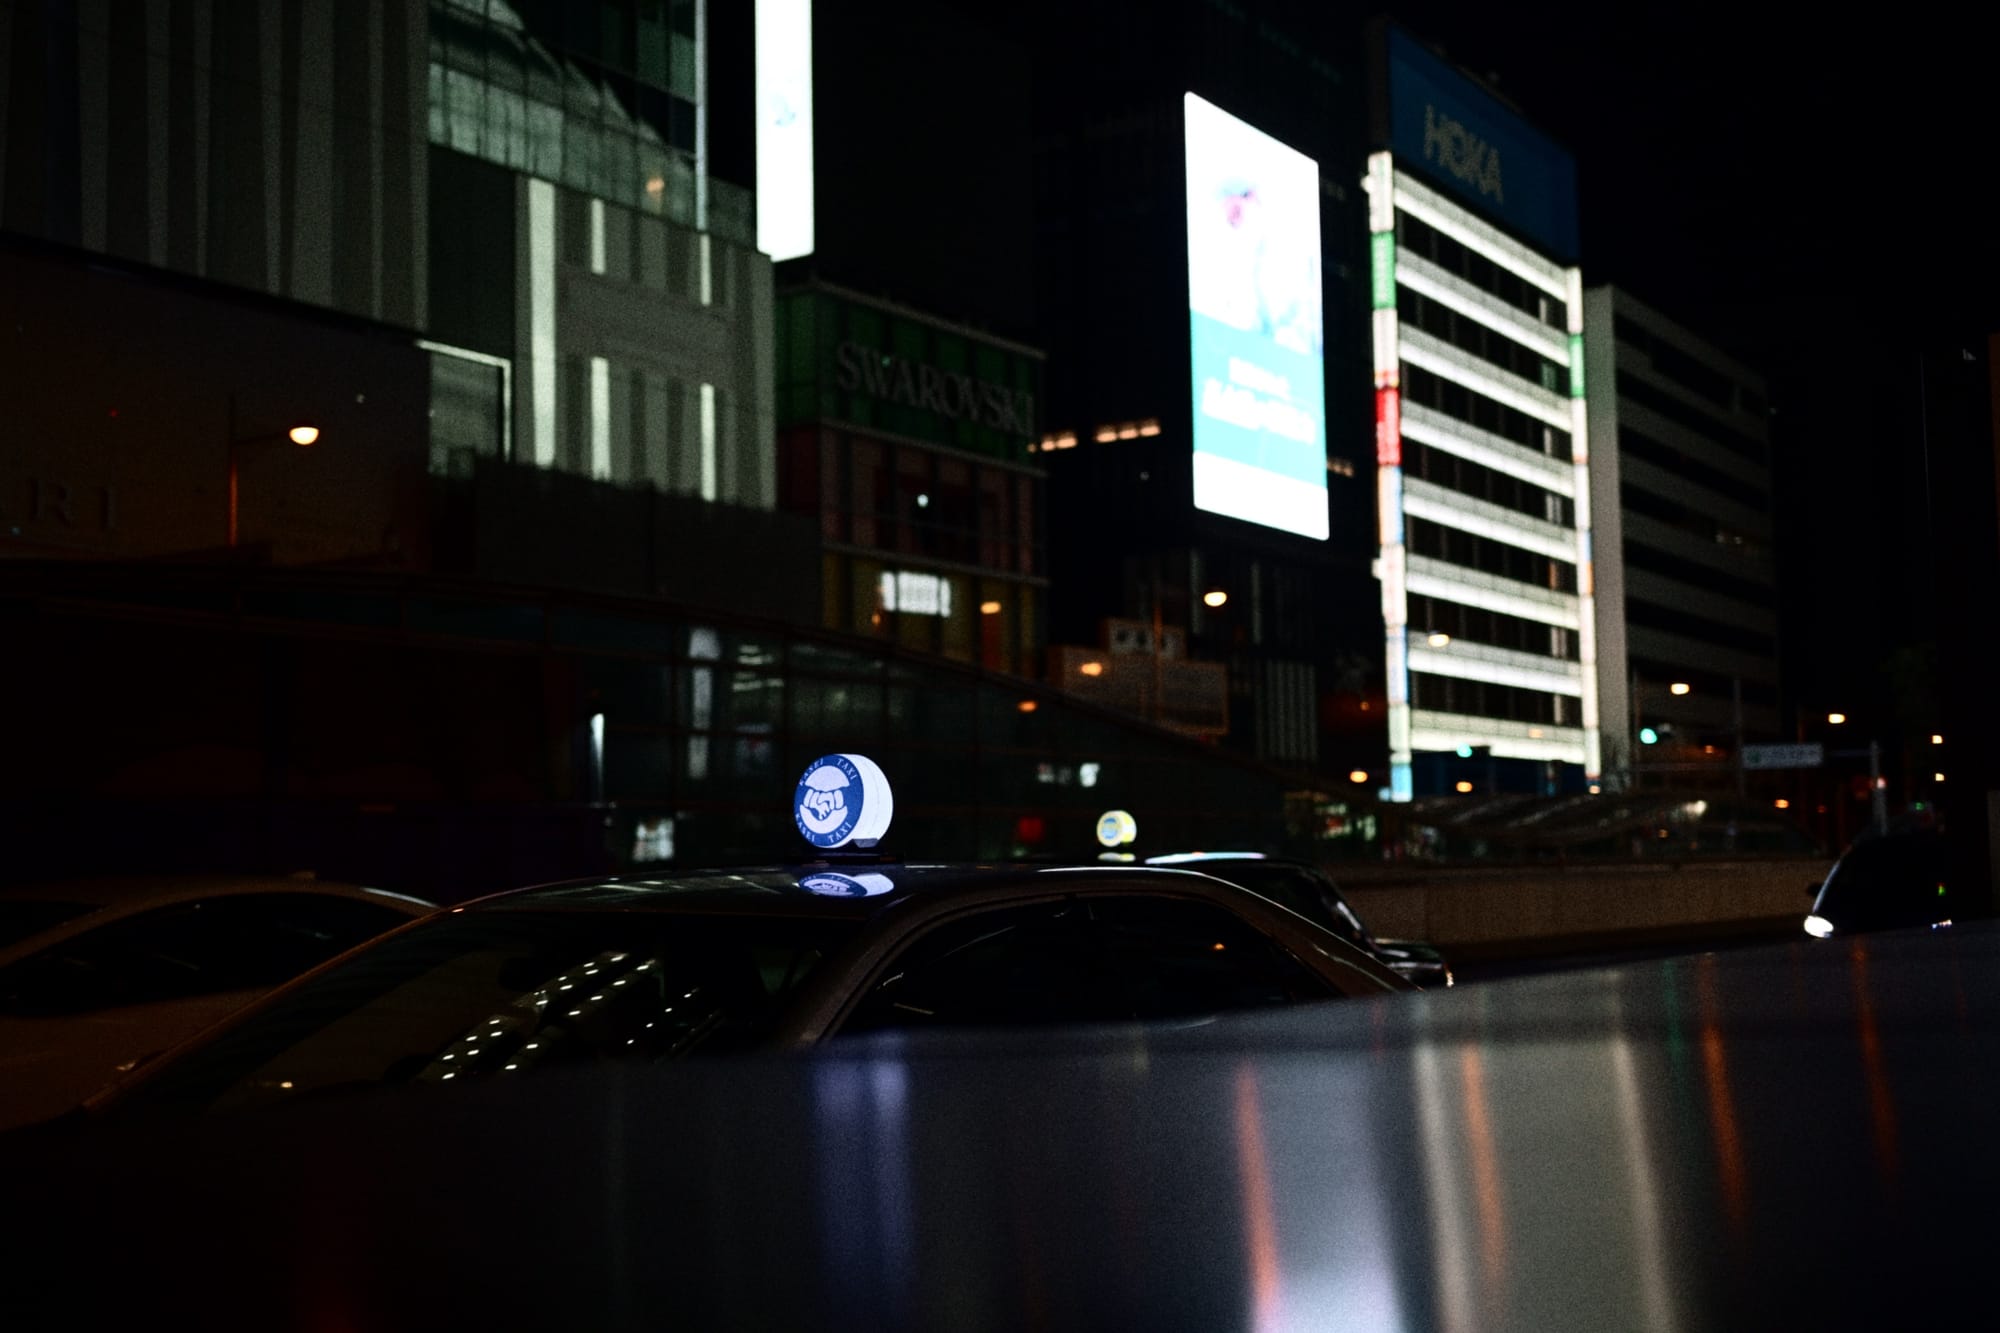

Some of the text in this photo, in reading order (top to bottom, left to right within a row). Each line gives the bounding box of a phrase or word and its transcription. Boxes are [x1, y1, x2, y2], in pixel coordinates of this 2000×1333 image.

[1424, 103, 1504, 205] HOKA
[836, 340, 1035, 438] SWAROVSKI
[836, 759, 857, 780] TAXI
[828, 822, 852, 843] TAXI
